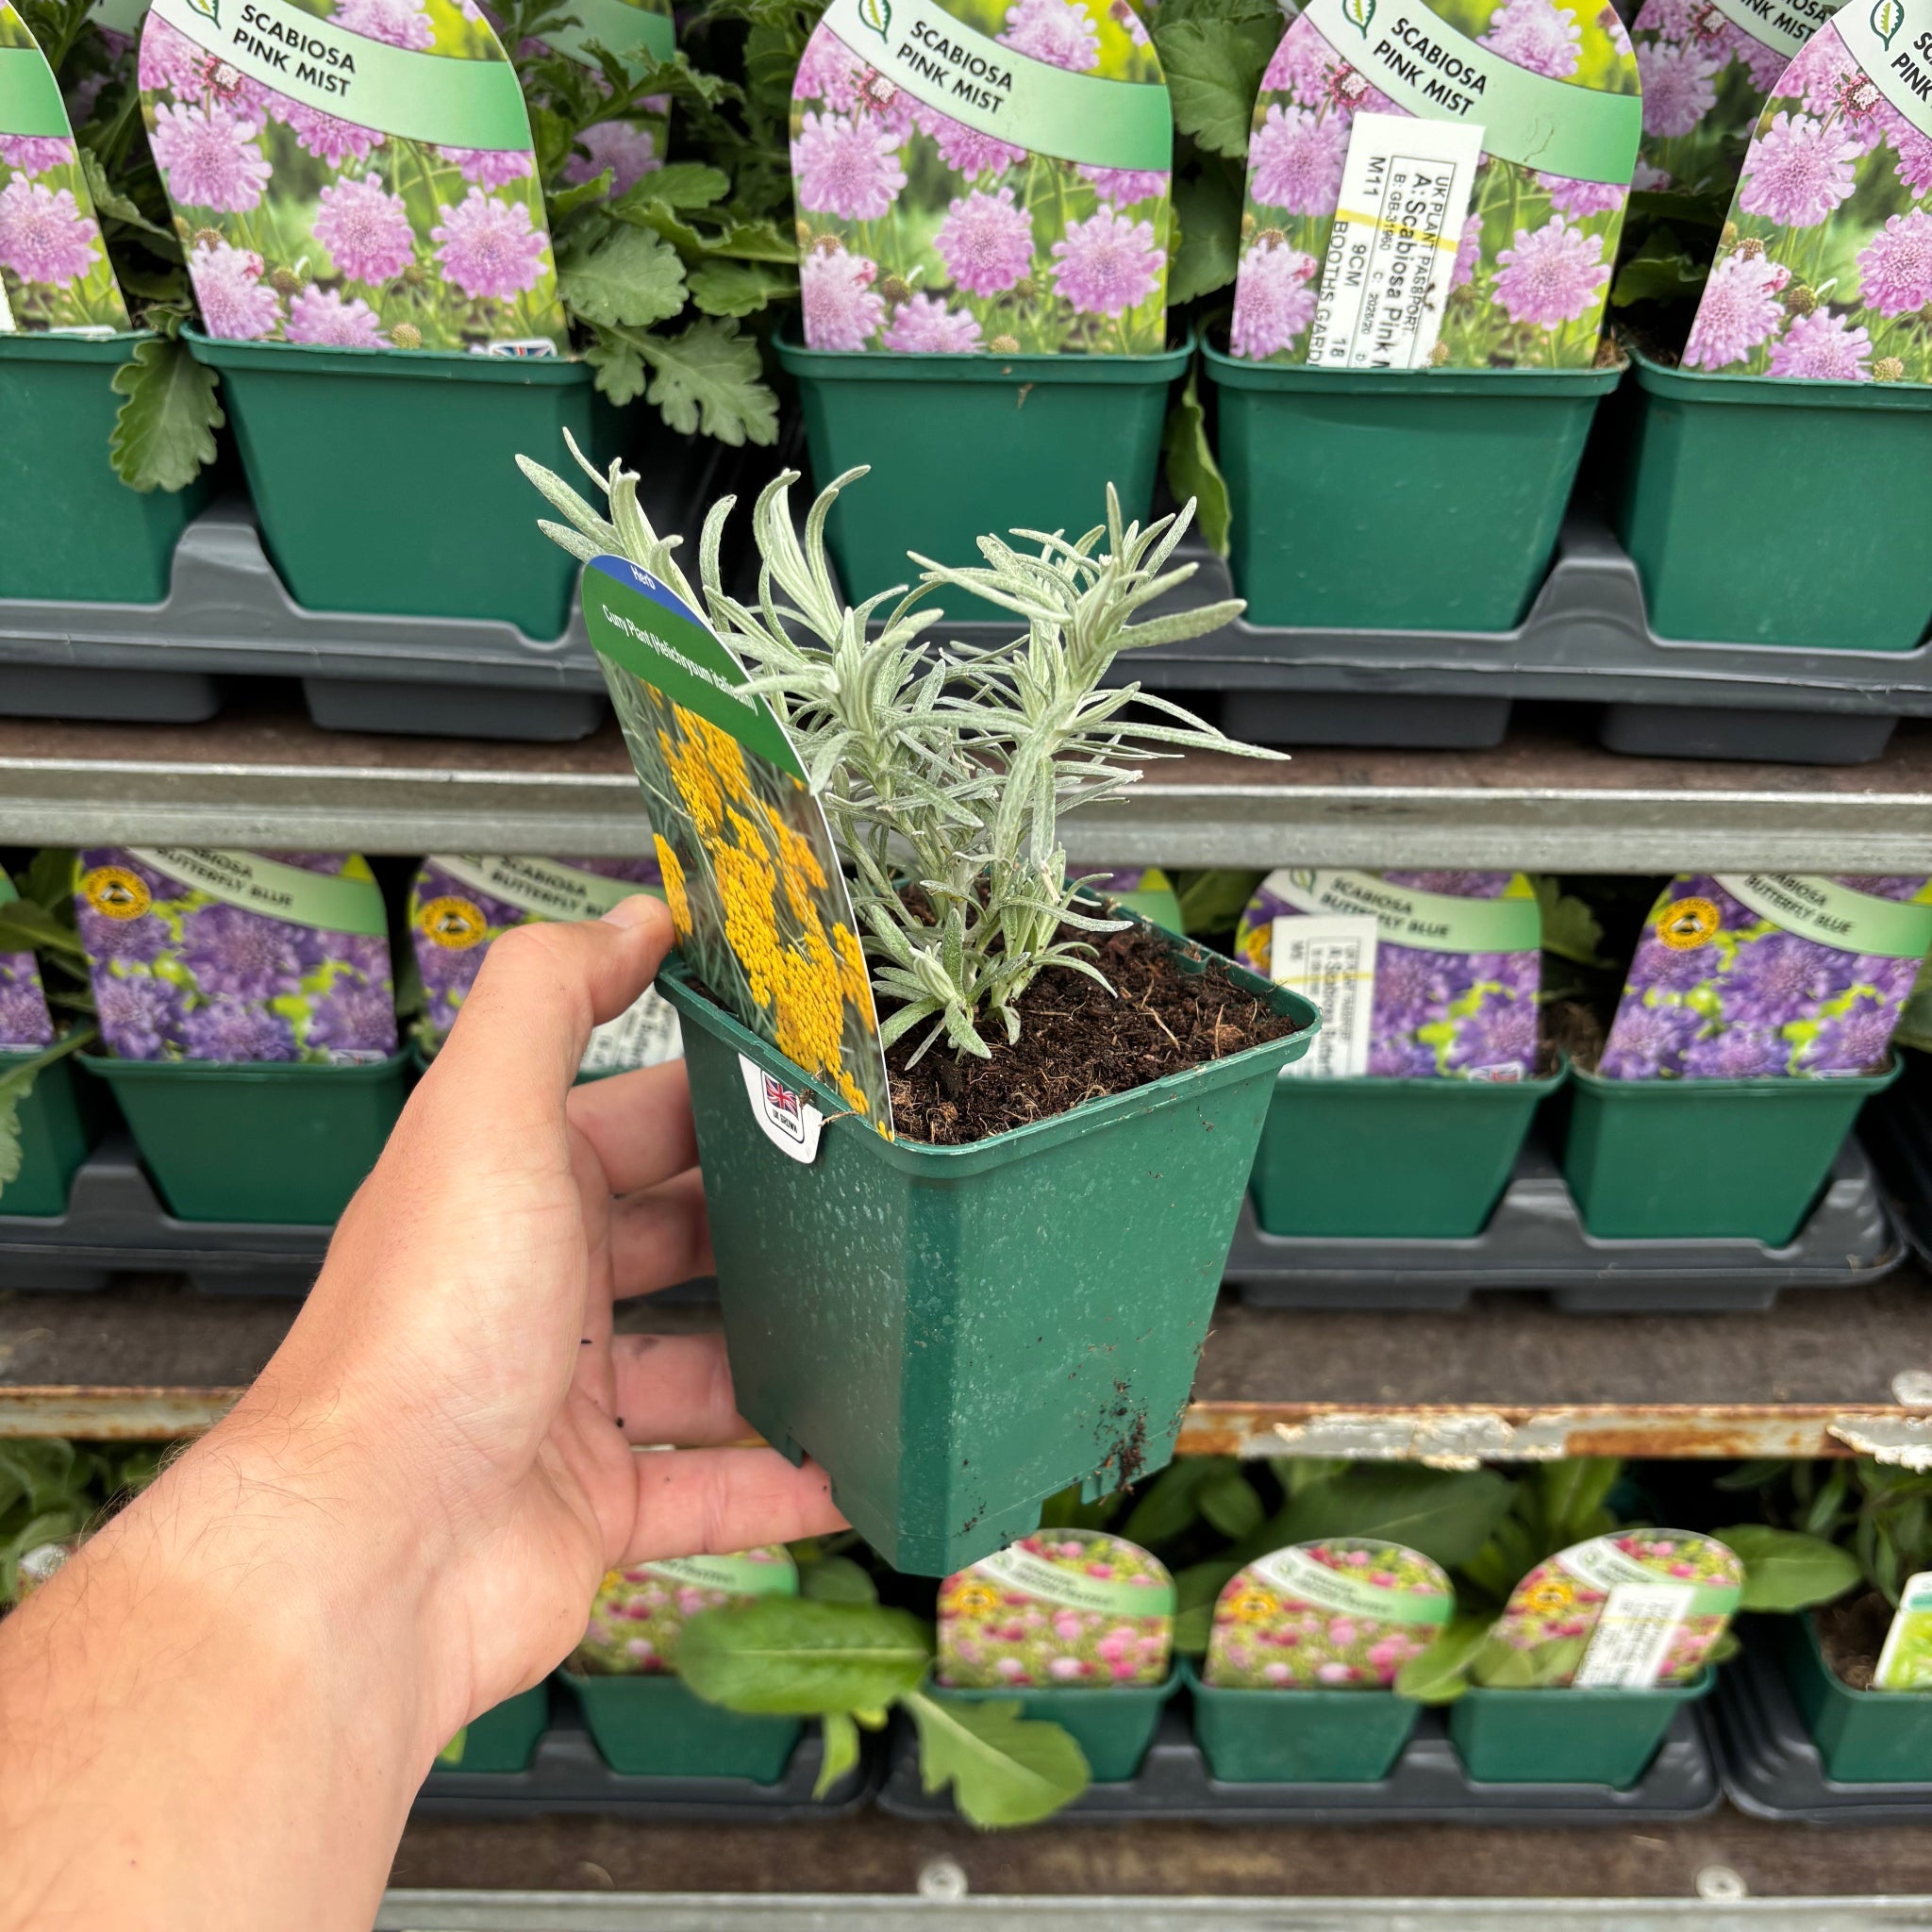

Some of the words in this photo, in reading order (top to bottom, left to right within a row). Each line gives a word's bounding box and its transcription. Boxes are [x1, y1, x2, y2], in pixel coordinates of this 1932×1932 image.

[242, 5, 356, 74] SCABIOSA
[1773, 13, 1816, 43] MIST
[232, 27, 291, 73] PINK
[295, 62, 351, 96] MIST
[896, 43, 950, 88] PINK
[951, 79, 1005, 114] MIST
[910, 21, 1012, 92] SCABIOSA
[1373, 40, 1424, 87] PINK
[1423, 79, 1474, 116] MIST
[1391, 17, 1487, 95] SCABIOSA
[1363, 156, 1386, 196] M11
[1432, 175, 1450, 198] UK
[1386, 200, 1426, 298] Scabiosa
[1420, 204, 1443, 249] PLANT
[1320, 220, 1349, 302] BOOTHS
[1343, 243, 1368, 287] 9CM
[1307, 308, 1331, 366] GARD
[1329, 338, 1347, 358] 18
[1374, 308, 1403, 353] Pink
[630, 564, 656, 590] Herb
[602, 604, 629, 637] Curry
[625, 618, 653, 648] Plant
[250, 885, 293, 906] BLUE
[1331, 876, 1412, 915] SCABIOSA
[1744, 874, 1816, 920] BUTTERFLY
[1813, 913, 1853, 936] BLUE
[1407, 919, 1449, 938] BLUE
